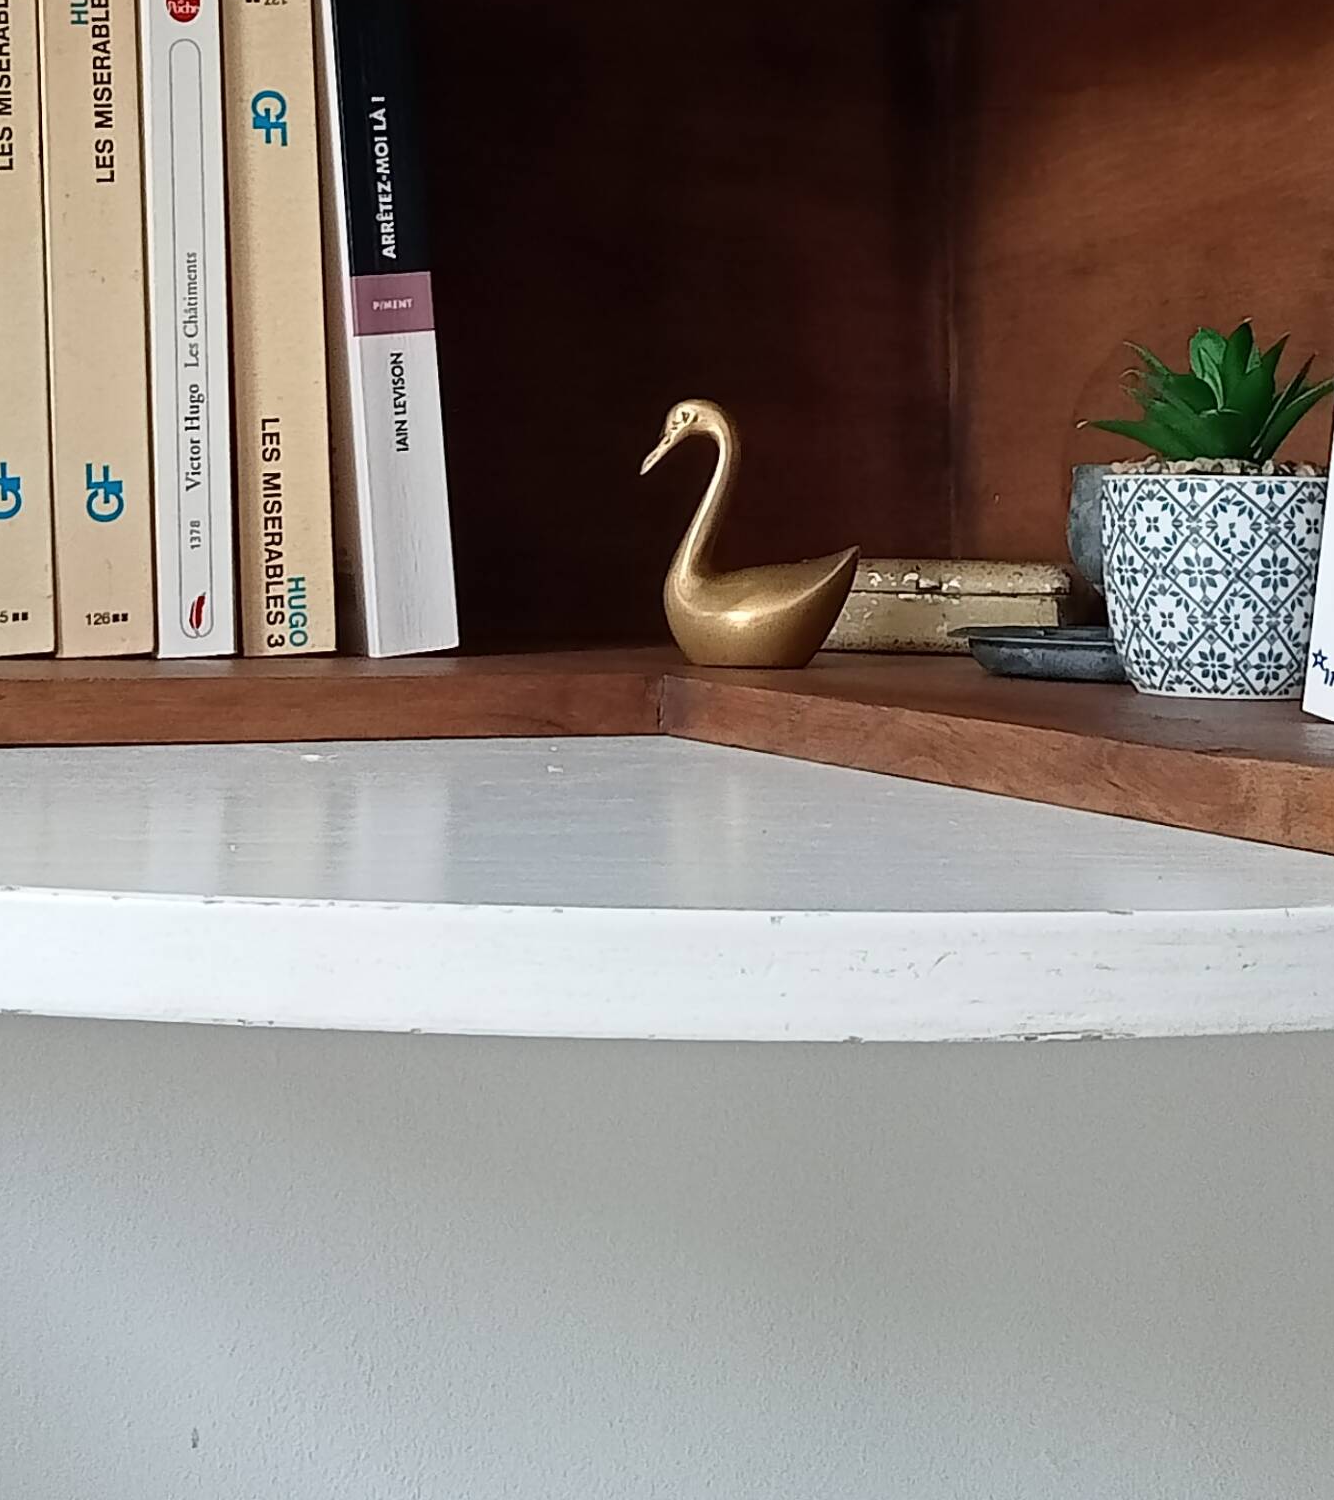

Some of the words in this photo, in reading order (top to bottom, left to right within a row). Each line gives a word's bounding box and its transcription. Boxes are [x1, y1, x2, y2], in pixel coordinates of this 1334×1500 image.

[251, 90, 288, 147] GF
[369, 108, 387, 130] LÀ
[95, 138, 115, 183] LES
[374, 137, 397, 259] ARRÊTEZ-MOI
[181, 252, 198, 338] Châtiments
[372, 298, 413, 311] PIMENT
[183, 342, 200, 369] Les
[390, 351, 408, 416] LEVISON
[184, 383, 205, 432] Hugo
[261, 417, 282, 463] LES
[395, 417, 410, 452] IAIN
[185, 436, 201, 492] Victor
[85, 463, 125, 523] GF
[190, 519, 201, 550] 1378
[262, 472, 286, 626] MISERABLES
[85, 612, 111, 626] 126
[287, 576, 309, 648] HUGO
[267, 634, 286, 649] 3
